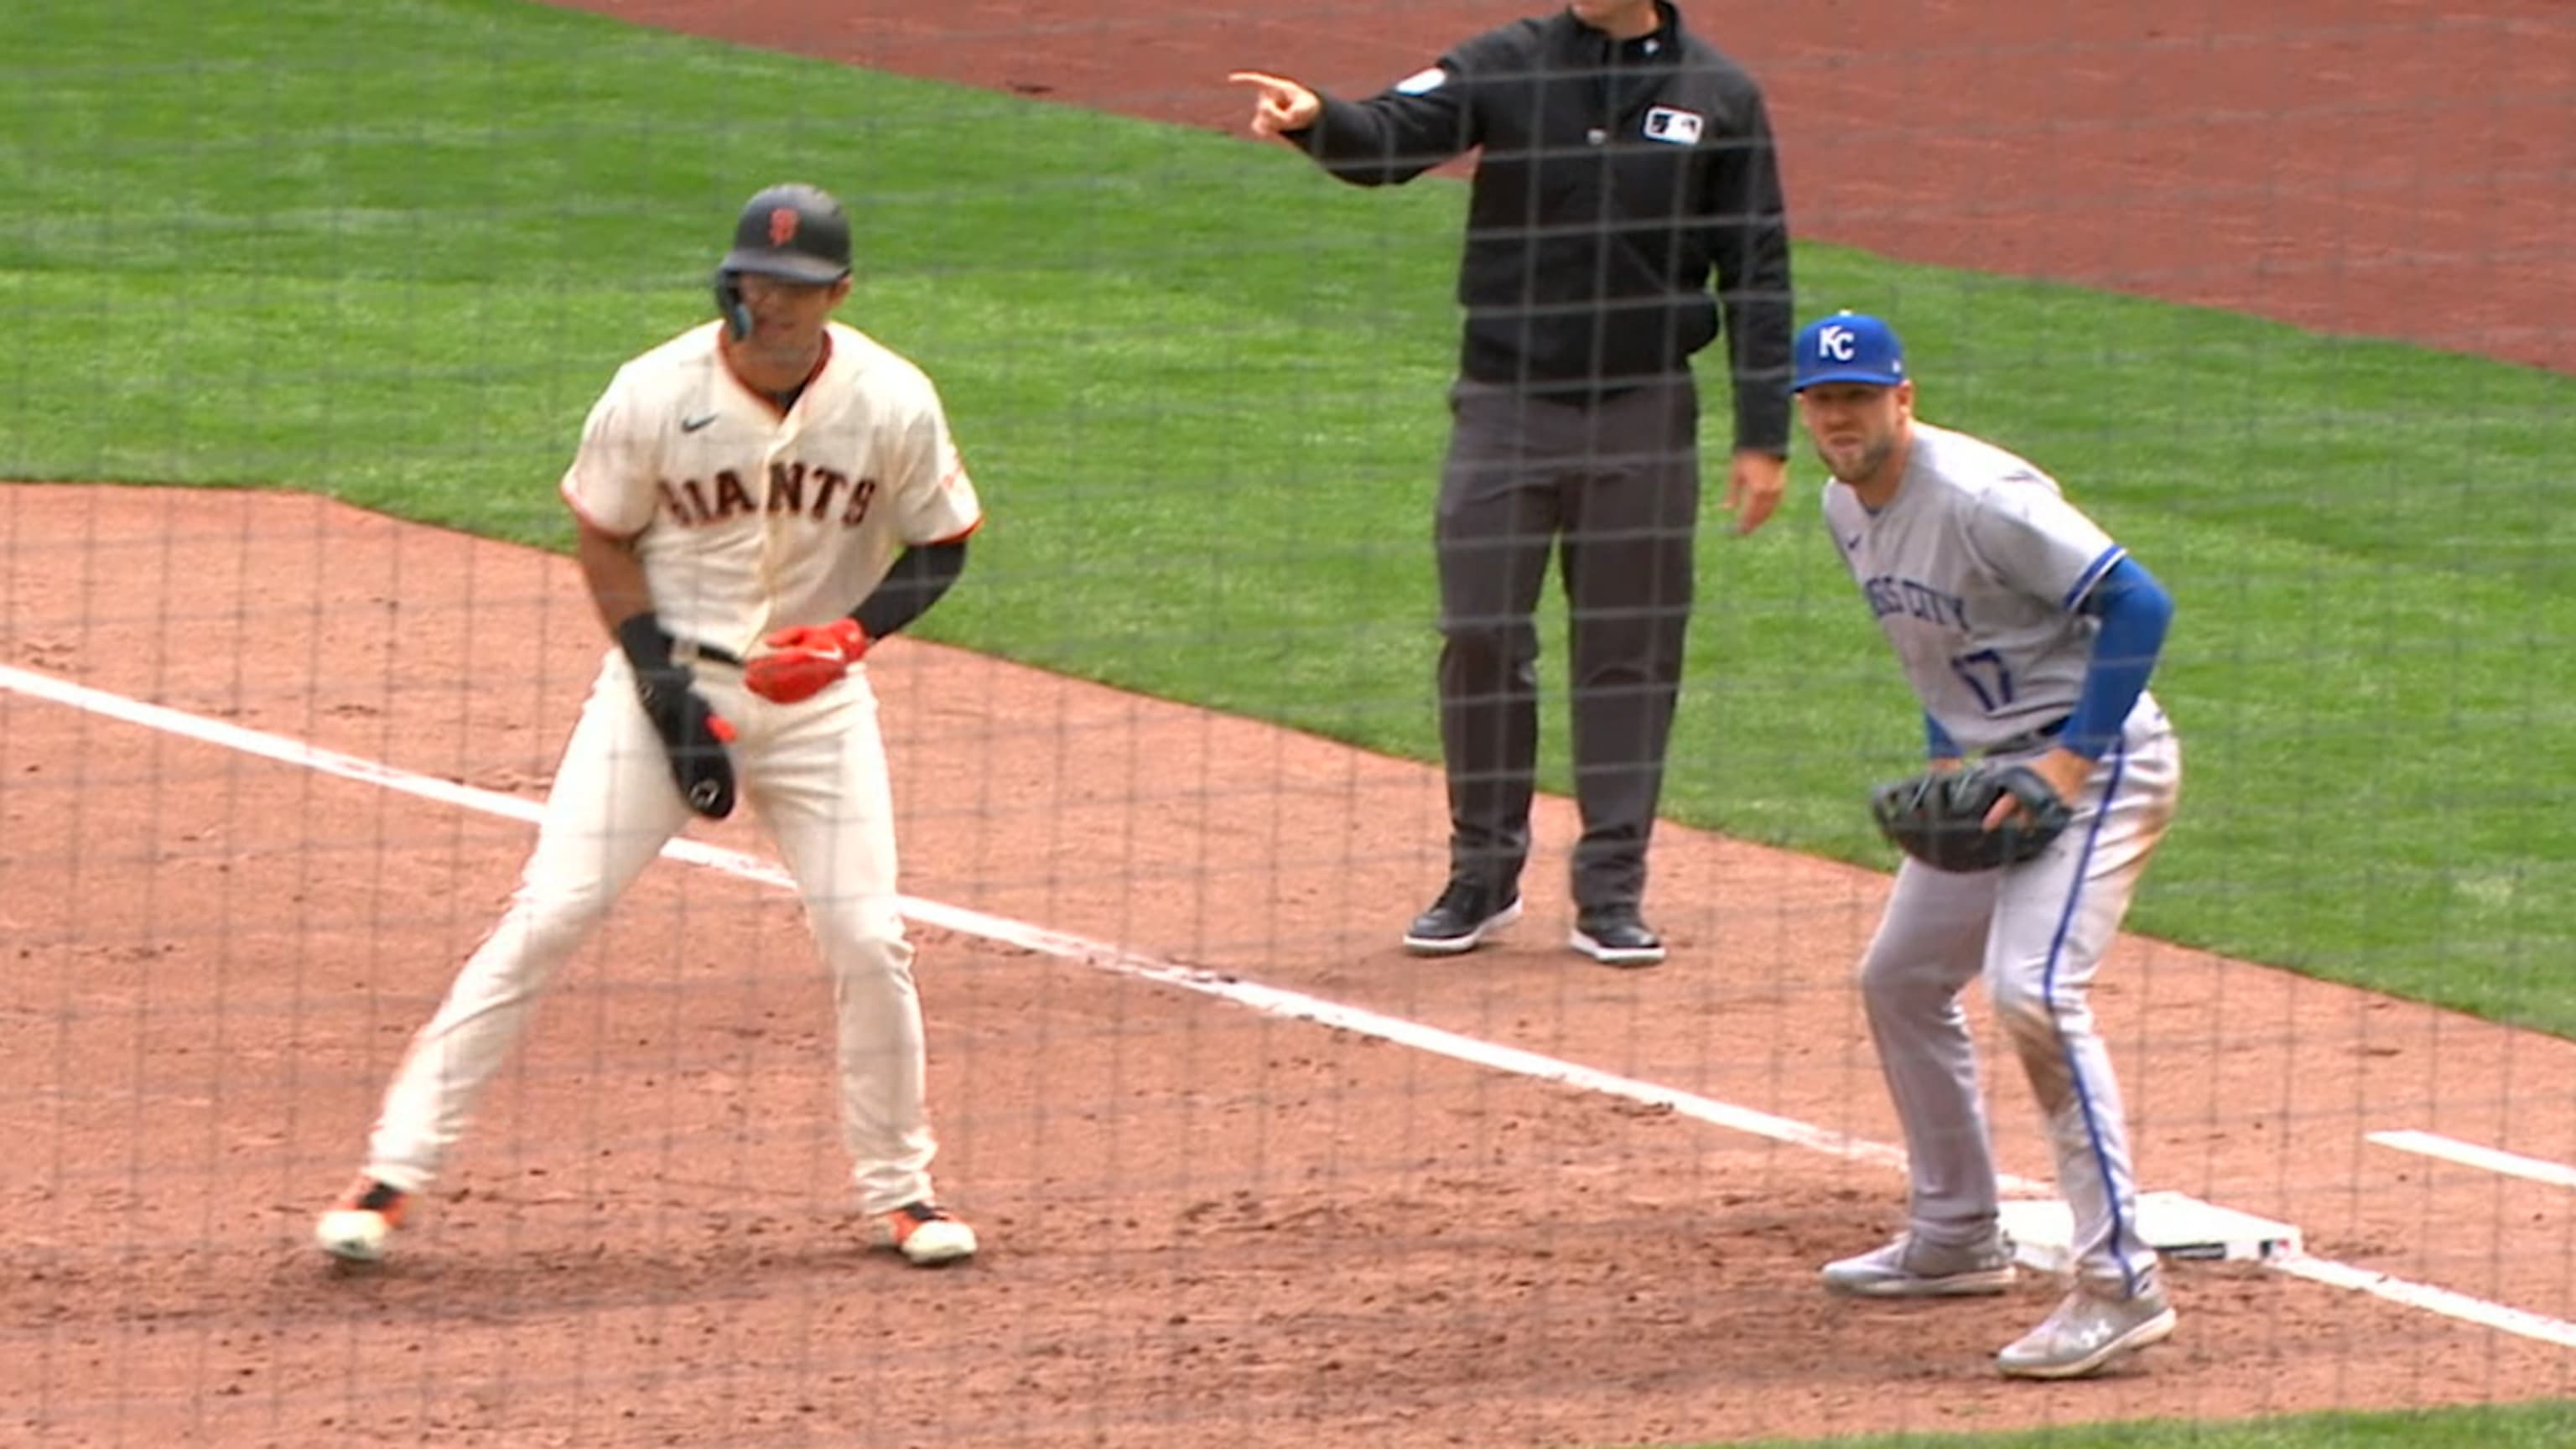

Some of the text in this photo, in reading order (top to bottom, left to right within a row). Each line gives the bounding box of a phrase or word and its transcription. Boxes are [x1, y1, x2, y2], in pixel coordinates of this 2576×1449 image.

[1819, 325, 1854, 361] KC
[1901, 579, 1970, 631] CITY
[1950, 648, 2013, 712] 17
